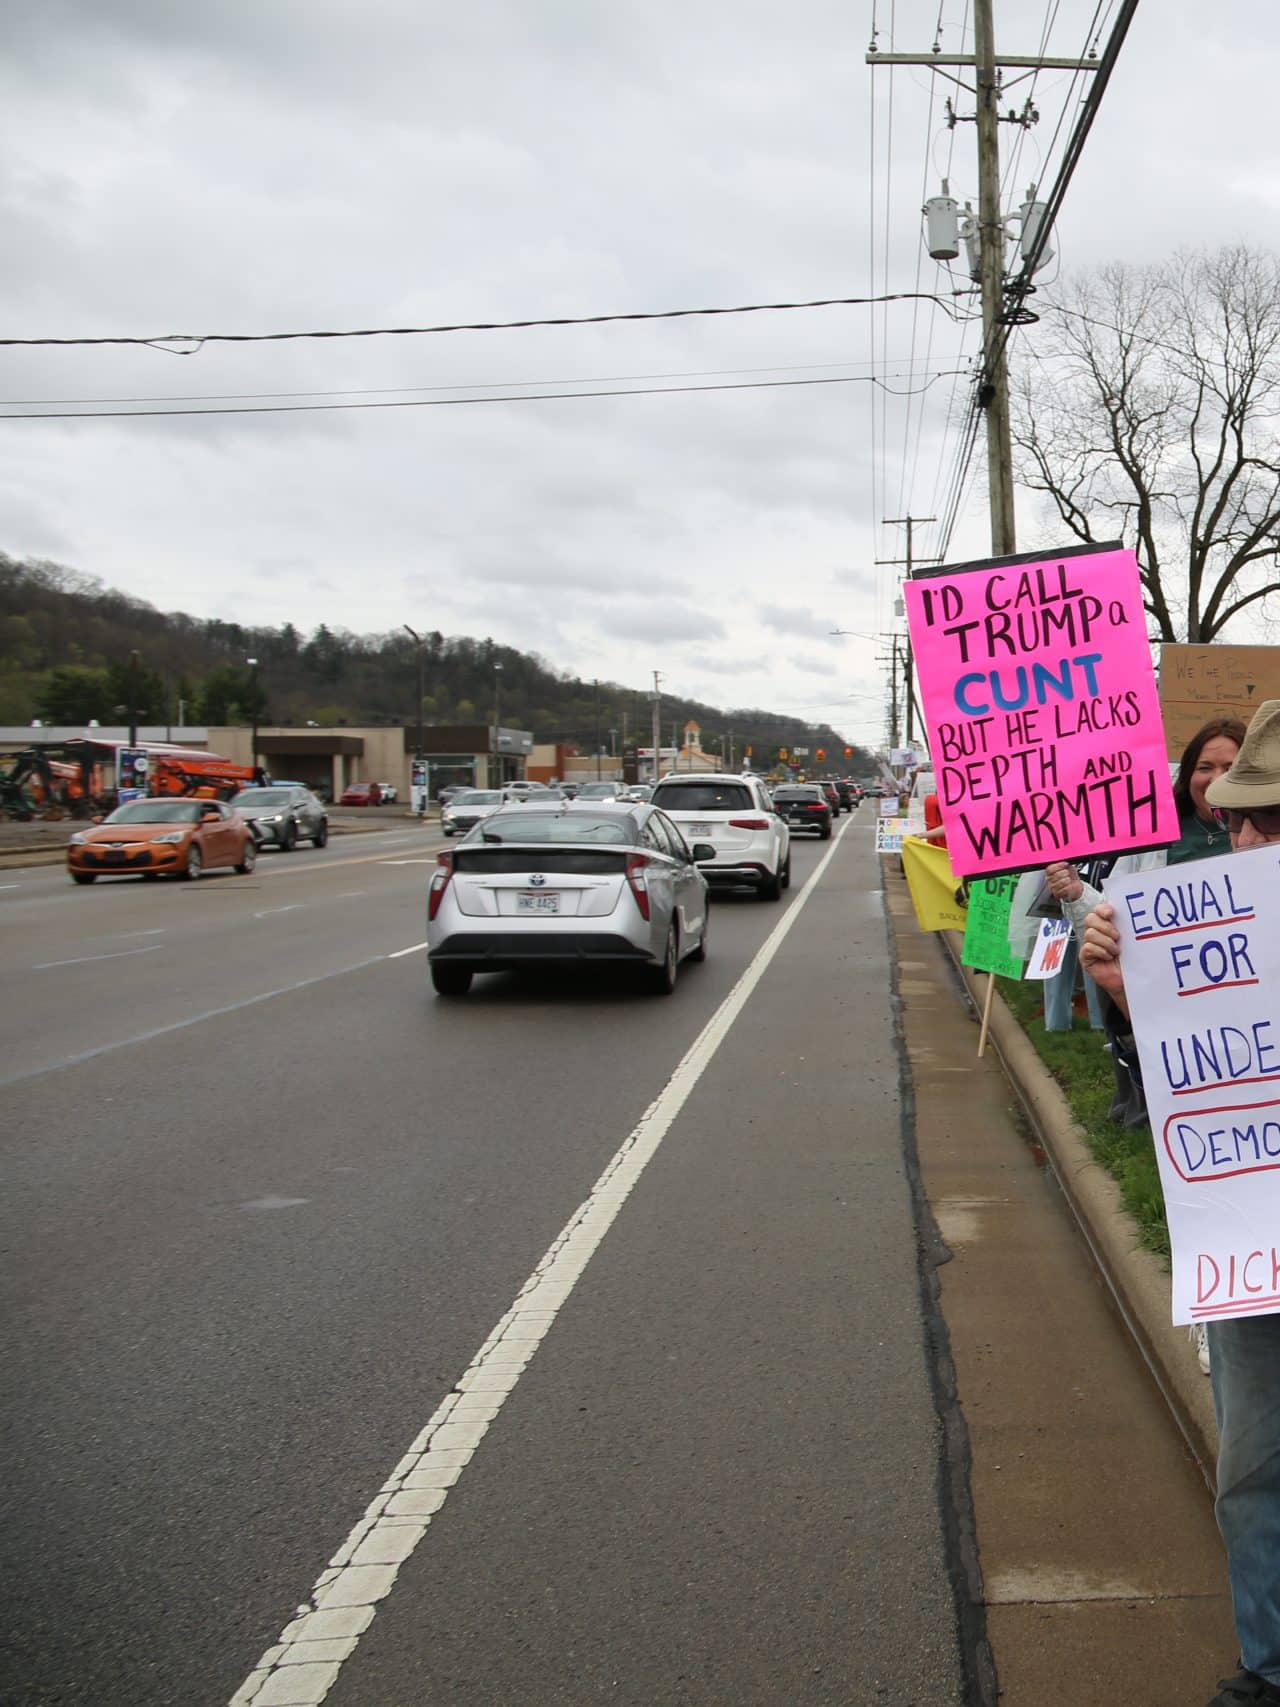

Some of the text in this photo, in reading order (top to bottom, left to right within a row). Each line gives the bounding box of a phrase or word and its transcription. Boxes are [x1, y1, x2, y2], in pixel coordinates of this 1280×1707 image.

[921, 564, 1083, 627] I'D CALL
[943, 595, 1129, 663] TRUMP a
[953, 652, 1103, 716] CUNT
[938, 691, 1142, 763] BUT HE LACKS
[942, 744, 1058, 807] DEPTH
[1083, 751, 1133, 780] AND
[959, 769, 1158, 860] WARMTH
[1126, 873, 1255, 935] EQUAL
[1170, 933, 1257, 989] FOR
